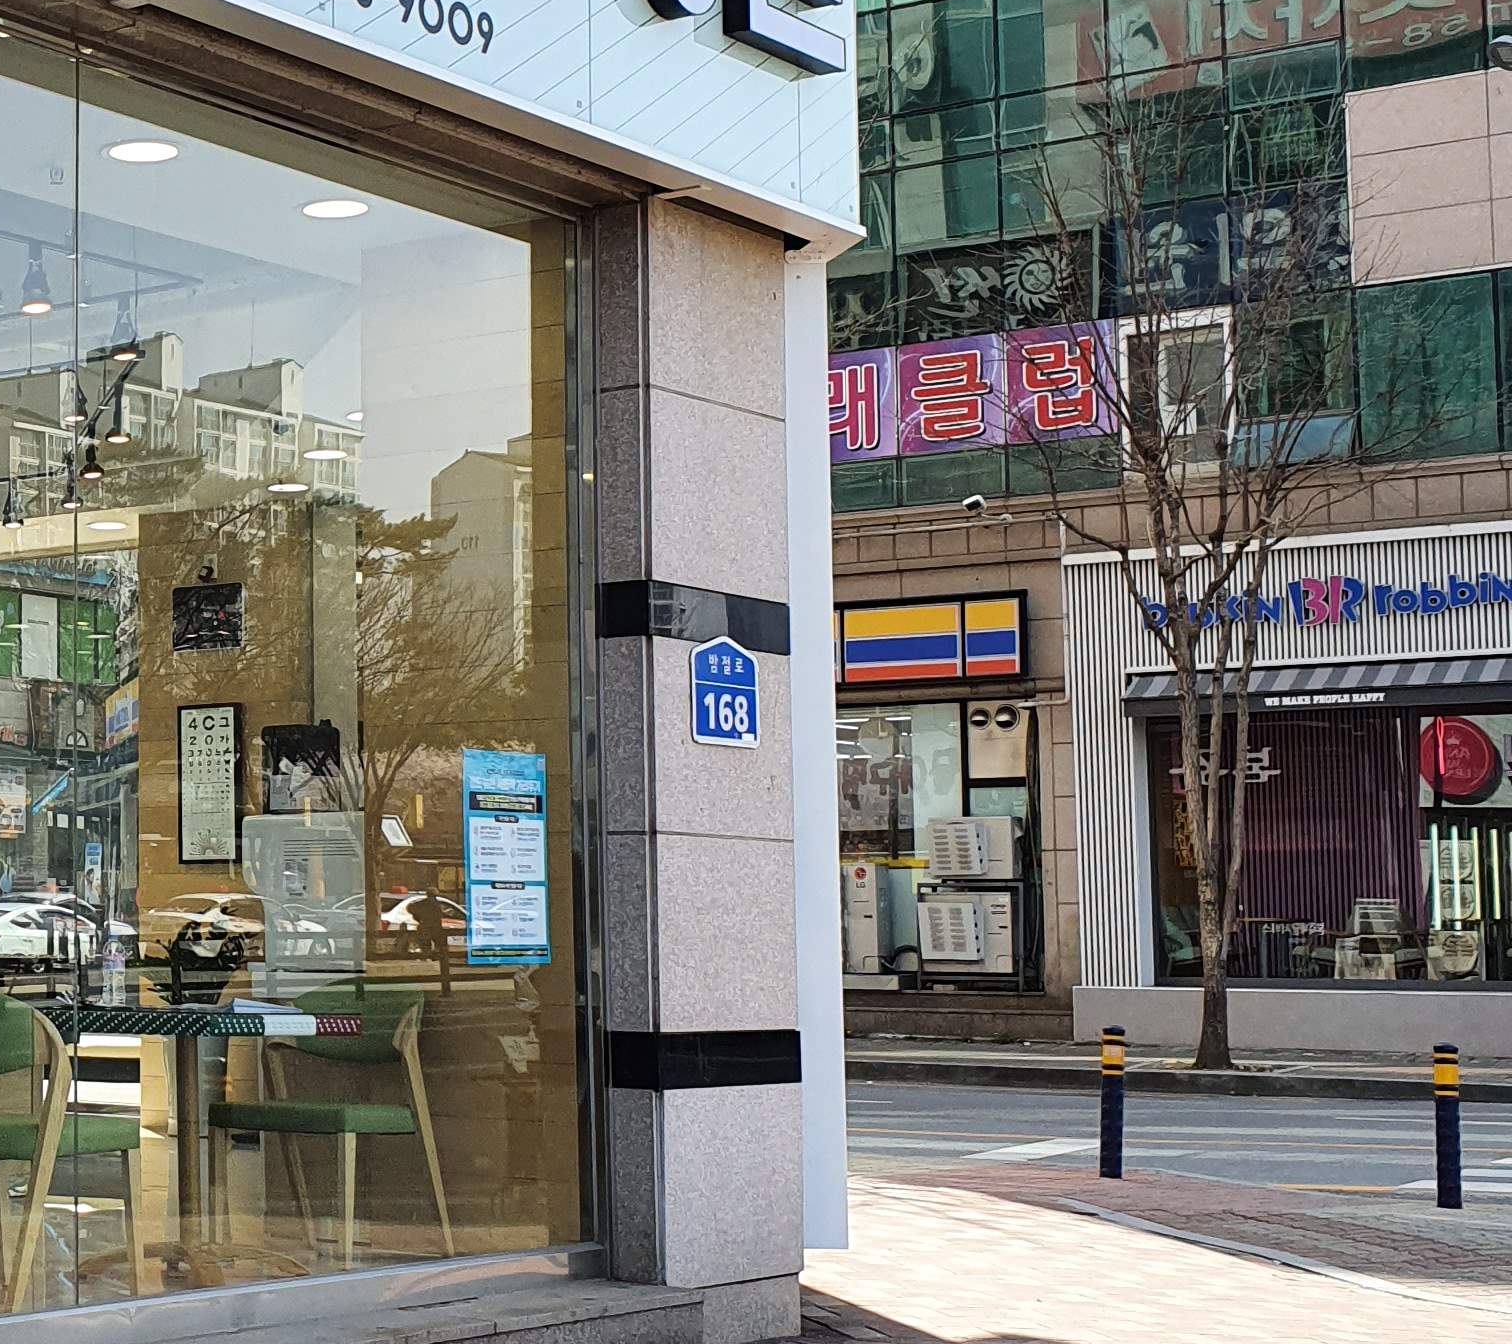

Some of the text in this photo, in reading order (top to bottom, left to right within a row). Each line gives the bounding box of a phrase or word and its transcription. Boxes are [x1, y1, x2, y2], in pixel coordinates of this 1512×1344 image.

[1287, 575, 1365, 626] BR
[1352, 692, 1386, 703] HAPPY
[703, 692, 749, 733] 168
[855, 881, 866, 889] LG
